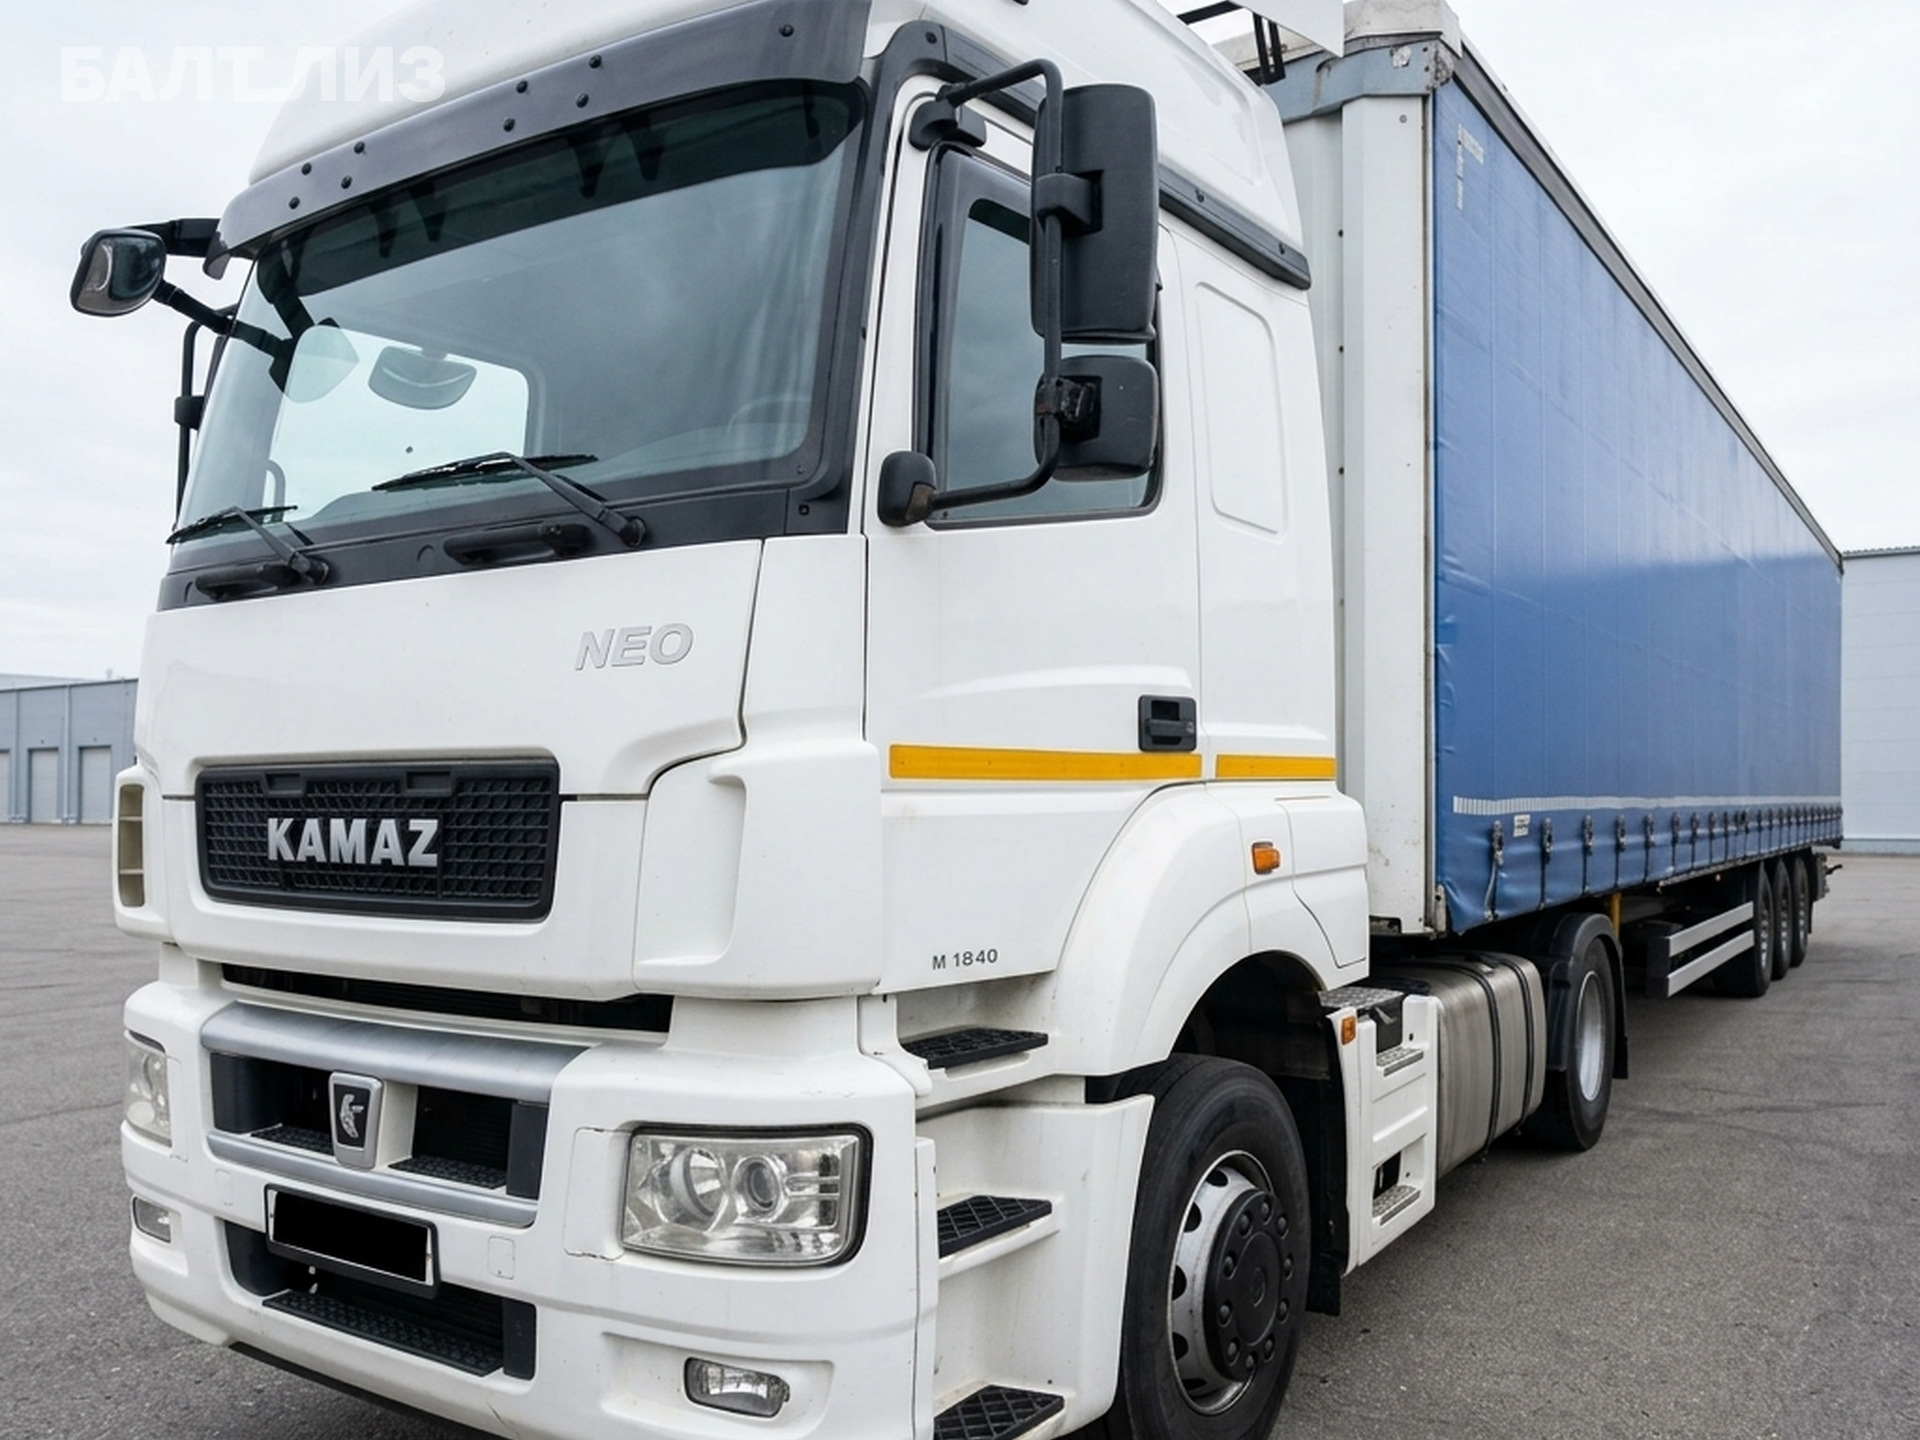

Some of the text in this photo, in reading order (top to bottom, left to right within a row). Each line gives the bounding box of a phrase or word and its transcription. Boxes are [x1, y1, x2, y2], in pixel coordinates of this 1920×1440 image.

[575, 623, 694, 671] NEO
[267, 818, 438, 867] KAMAZ
[933, 948, 998, 970] M 1840
